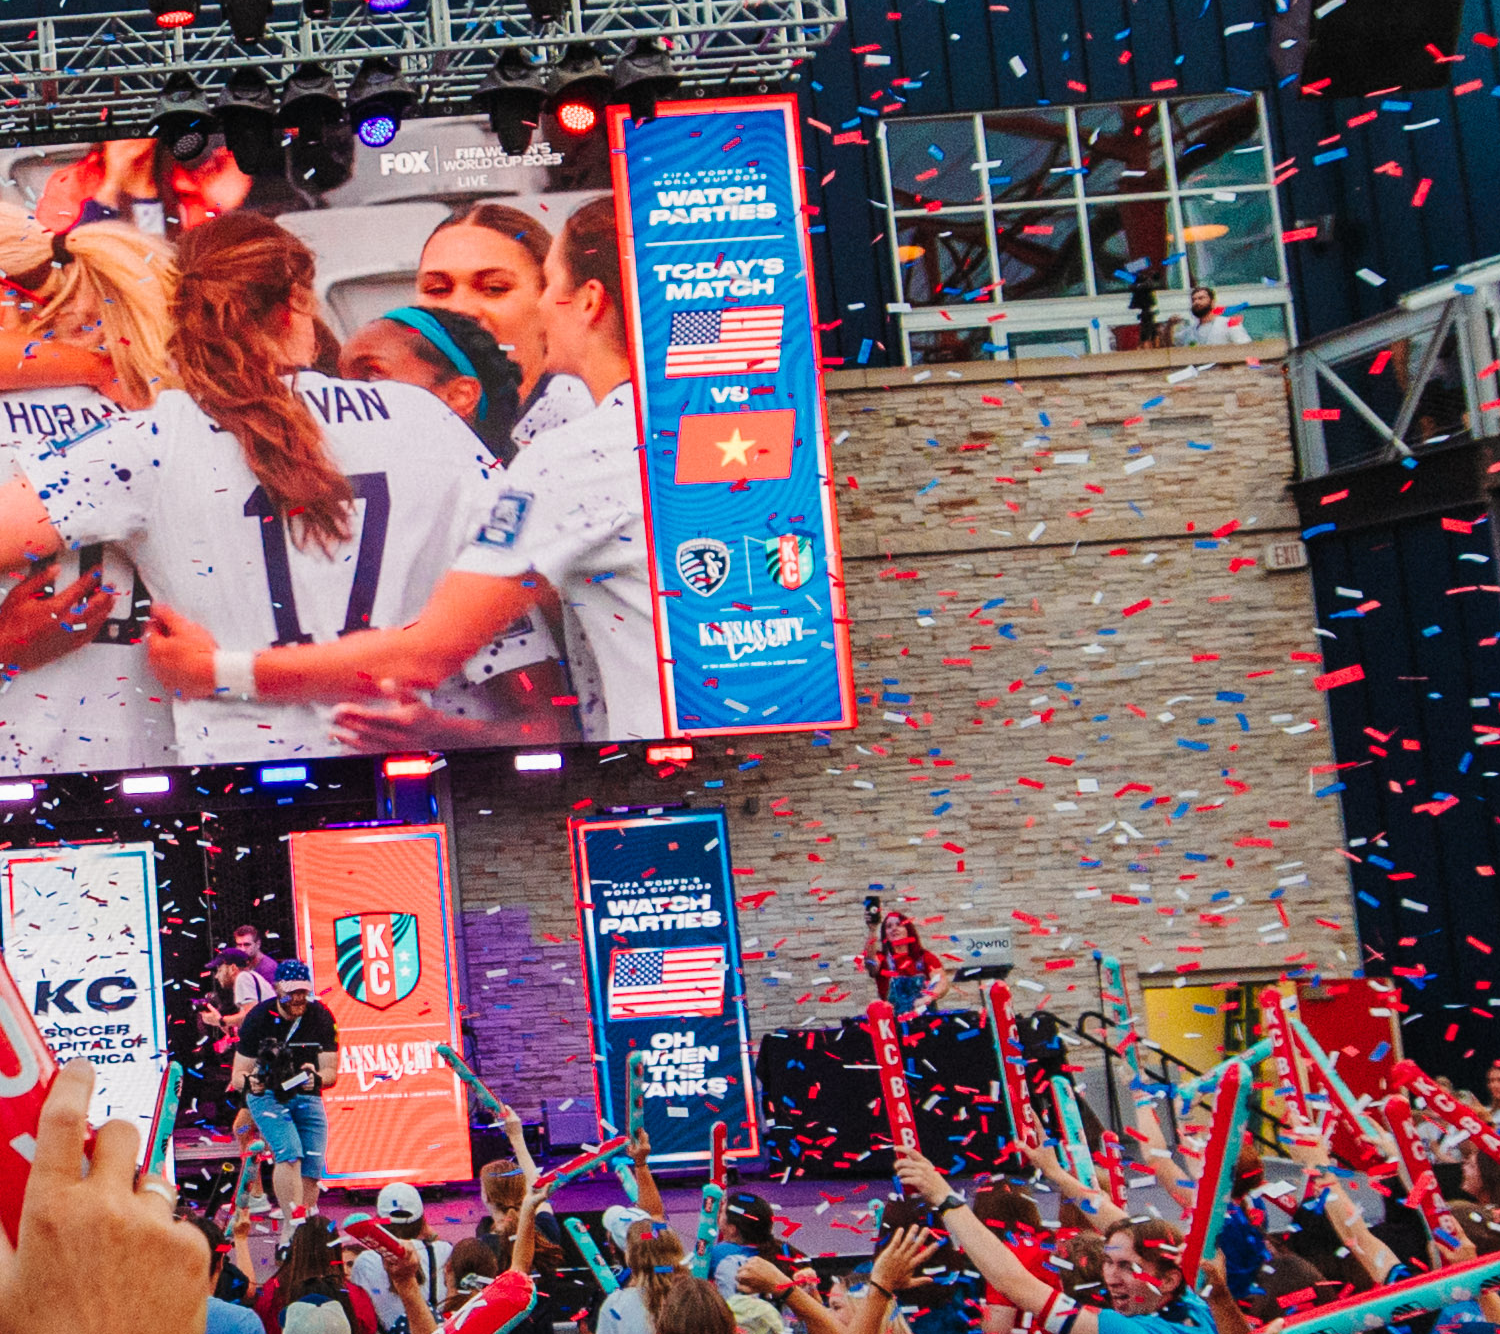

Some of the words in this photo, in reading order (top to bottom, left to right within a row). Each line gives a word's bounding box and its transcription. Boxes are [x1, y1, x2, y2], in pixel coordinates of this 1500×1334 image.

[657, 185, 767, 208] WATCH
[649, 203, 777, 226] PARTIES
[652, 258, 785, 283] TODAY'S
[665, 278, 775, 302] MATCH
[711, 386, 749, 404] VS
[243, 471, 391, 649] 17
[783, 541, 799, 583] KC
[606, 894, 711, 917] WATCH
[600, 910, 722, 935] PARTIES
[366, 923, 392, 996] KC
[34, 976, 138, 1016] KC
[44, 1023, 131, 1039] SOCCER
[1264, 1006, 1285, 1048] KC
[651, 1031, 695, 1049] OH
[877, 1018, 900, 1066] KC
[337, 1043, 399, 1075] ANSAS
[648, 1063, 705, 1082] THE
[1410, 1076, 1458, 1113] KC
